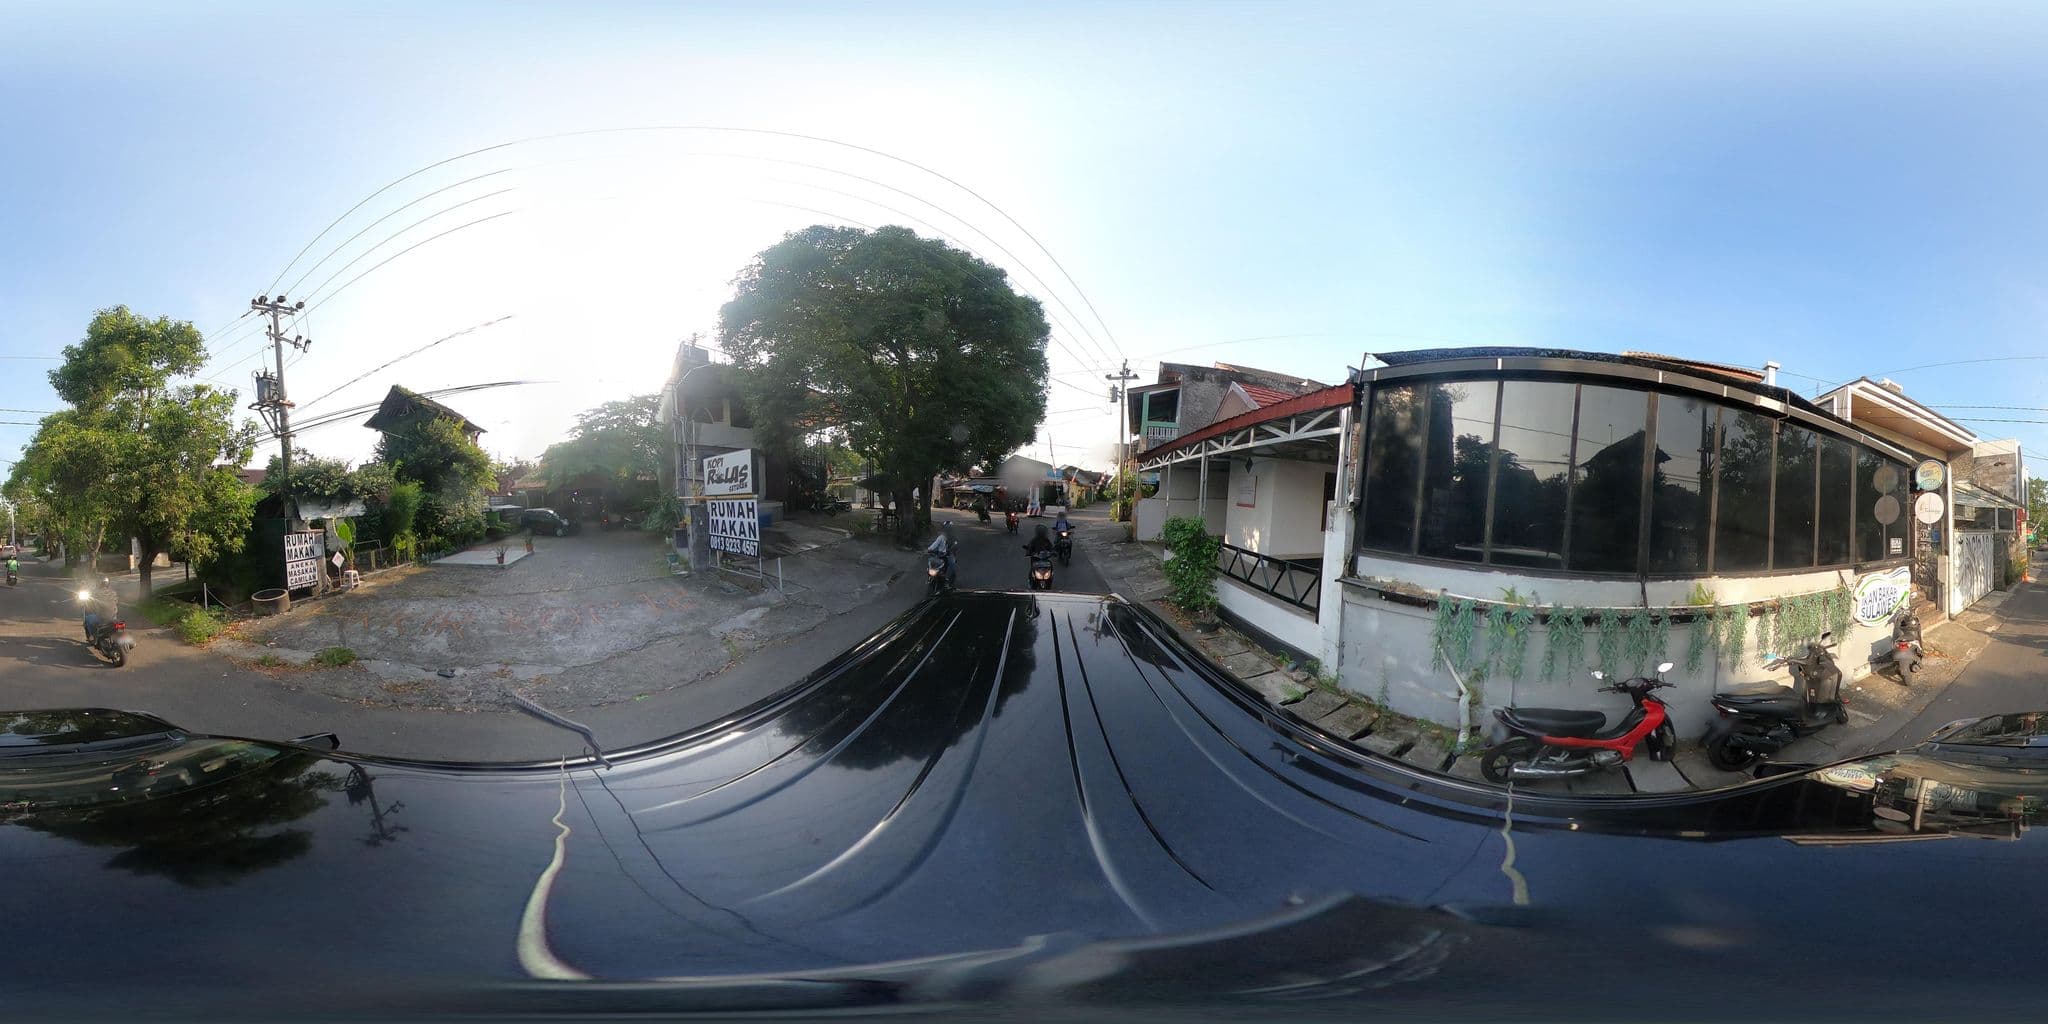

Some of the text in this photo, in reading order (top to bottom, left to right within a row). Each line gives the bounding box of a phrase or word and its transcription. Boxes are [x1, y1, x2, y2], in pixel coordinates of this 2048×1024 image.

[707, 457, 724, 469] KOPI
[711, 502, 755, 519] RUMAH
[711, 519, 757, 539] MAKAN
[286, 533, 314, 547] RUMAH
[710, 536, 725, 551] 0813
[742, 540, 758, 557] 4567
[287, 546, 315, 560] MAKAN
[288, 567, 316, 577] MASAKAN
[291, 561, 313, 569] ANEKA
[290, 575, 316, 584] CAMILAN
